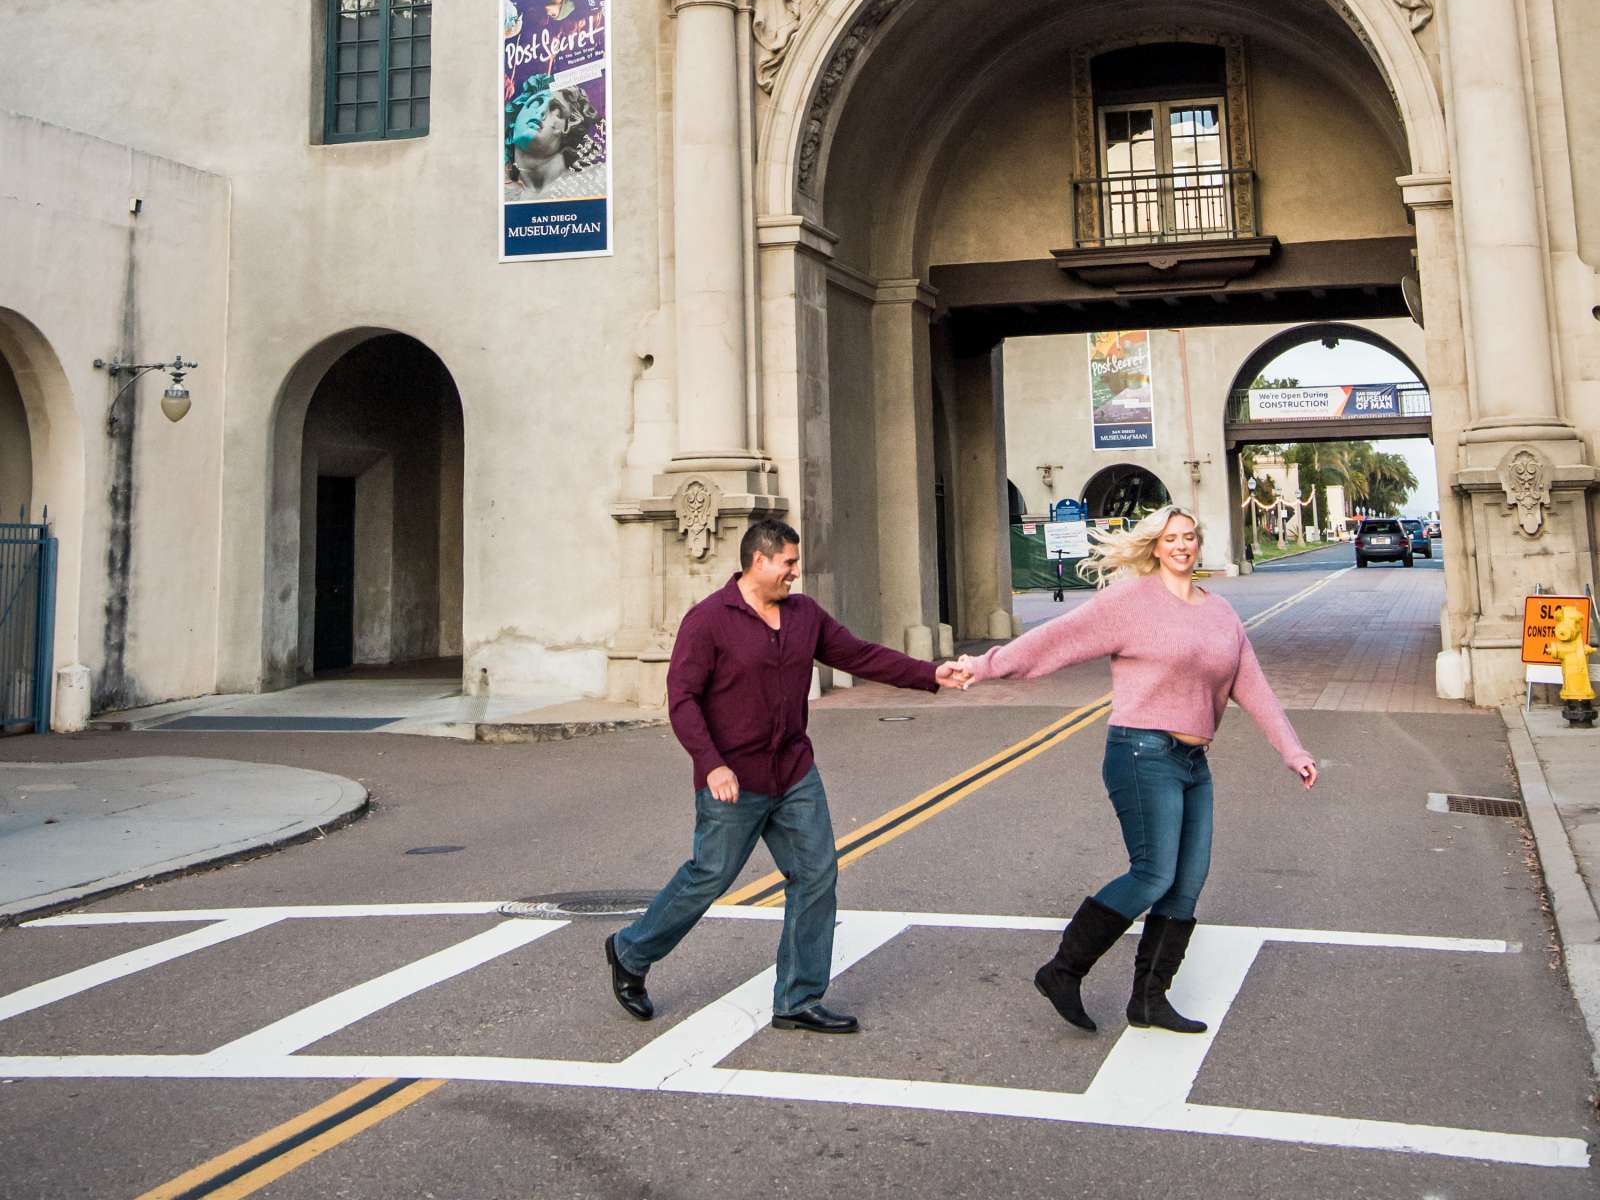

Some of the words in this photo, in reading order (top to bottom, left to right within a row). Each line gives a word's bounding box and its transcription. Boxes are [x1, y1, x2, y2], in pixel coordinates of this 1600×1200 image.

[531, 215, 548, 224] SAN
[550, 213, 577, 222] DIEGO
[508, 225, 560, 238] MUSEUM
[560, 223, 571, 237] of
[571, 222, 601, 234] MAN
[1259, 392, 1279, 400] We're
[1281, 392, 1301, 400] Open
[1302, 391, 1329, 399] During
[1356, 395, 1392, 403] MUSEUM
[1259, 400, 1329, 409] CONSTRUCTION!
[1356, 402, 1369, 410] OF
[1370, 401, 1393, 409] MAN
[1540, 605, 1562, 619] SL
[1527, 626, 1556, 638] CONSTR
